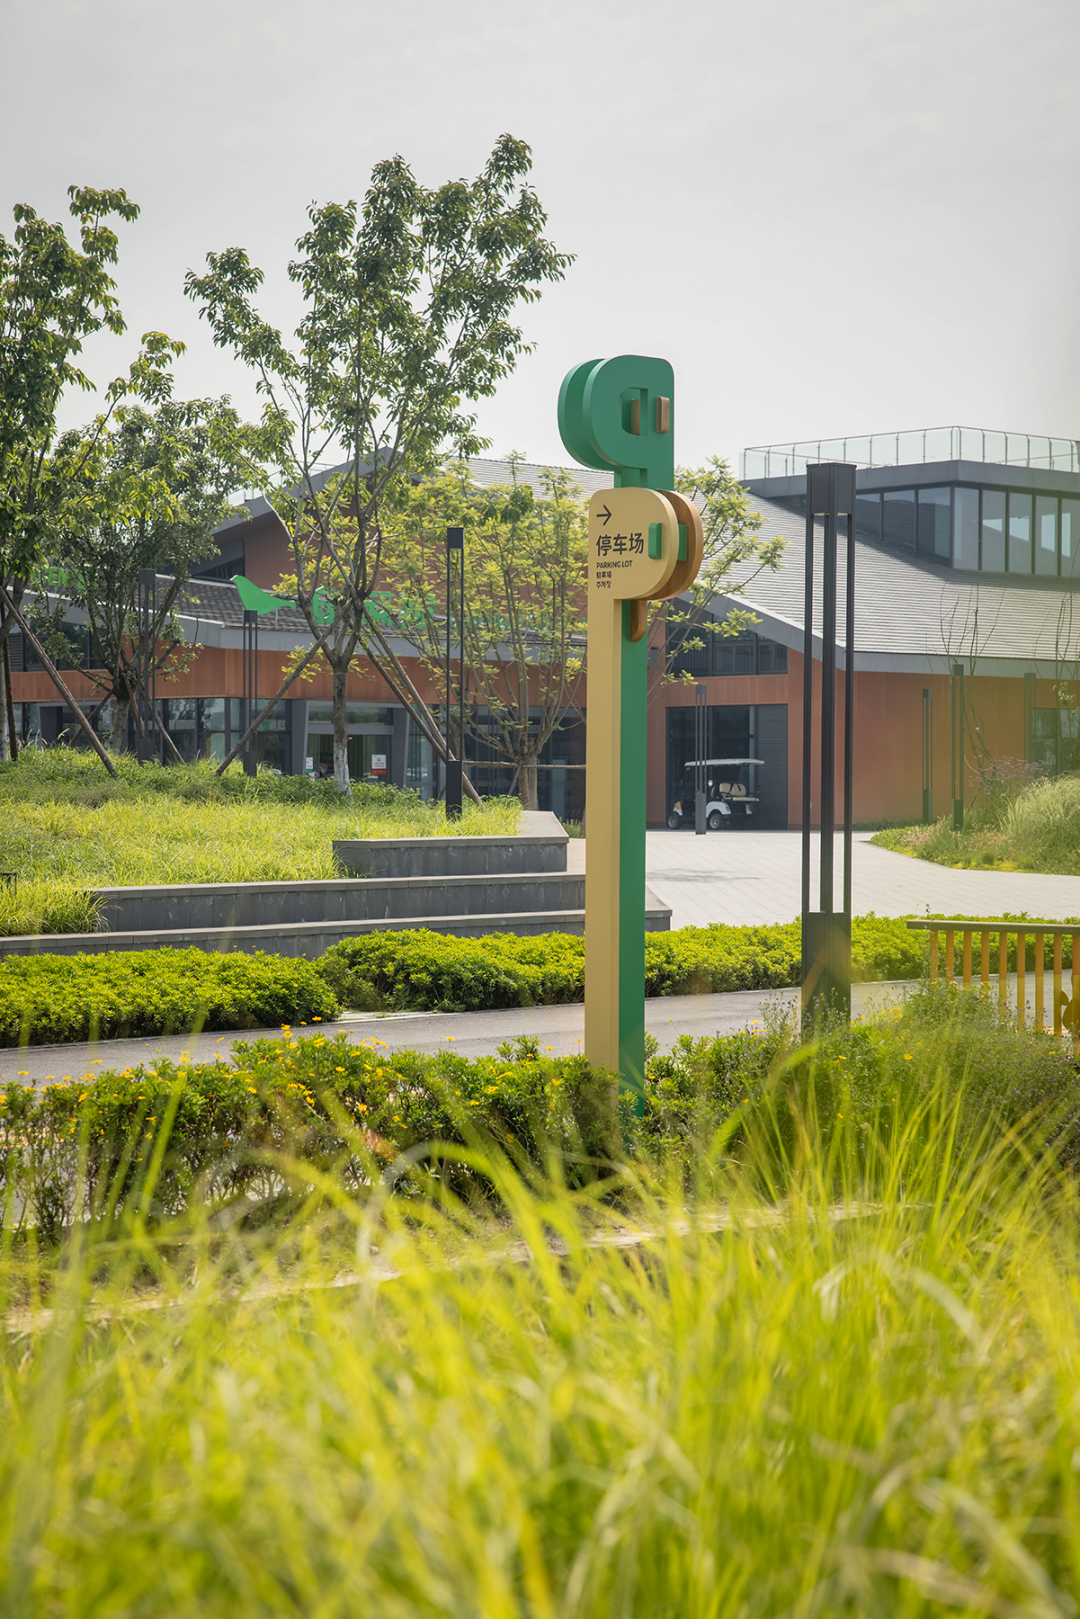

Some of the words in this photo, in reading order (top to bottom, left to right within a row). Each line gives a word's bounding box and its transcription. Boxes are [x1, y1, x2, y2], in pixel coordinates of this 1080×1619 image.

[596, 533, 644, 556] 停车场
[596, 561, 621, 569] PARKING
[622, 560, 633, 568] LOT
